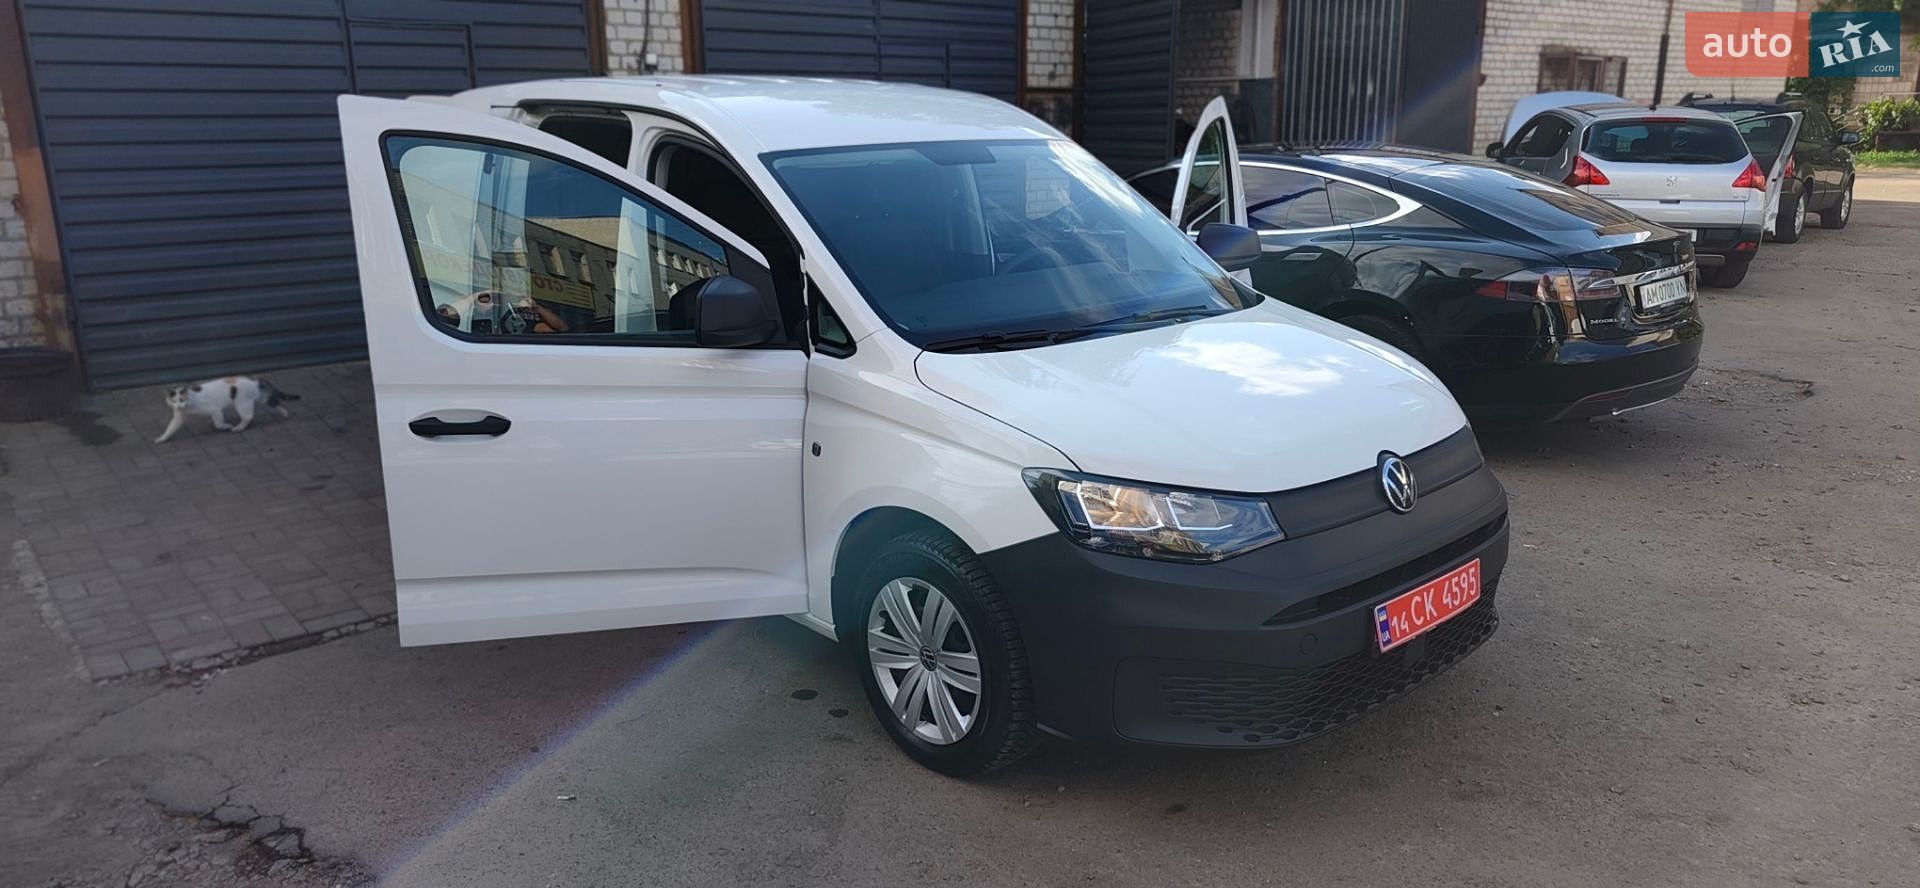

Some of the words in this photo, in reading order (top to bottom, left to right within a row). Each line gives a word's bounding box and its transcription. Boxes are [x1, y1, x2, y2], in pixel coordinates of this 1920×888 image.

[1391, 611, 1409, 638] 14
[1411, 588, 1437, 625] CK
[1442, 566, 1477, 609] 4595
[1381, 630, 1391, 642] UA
